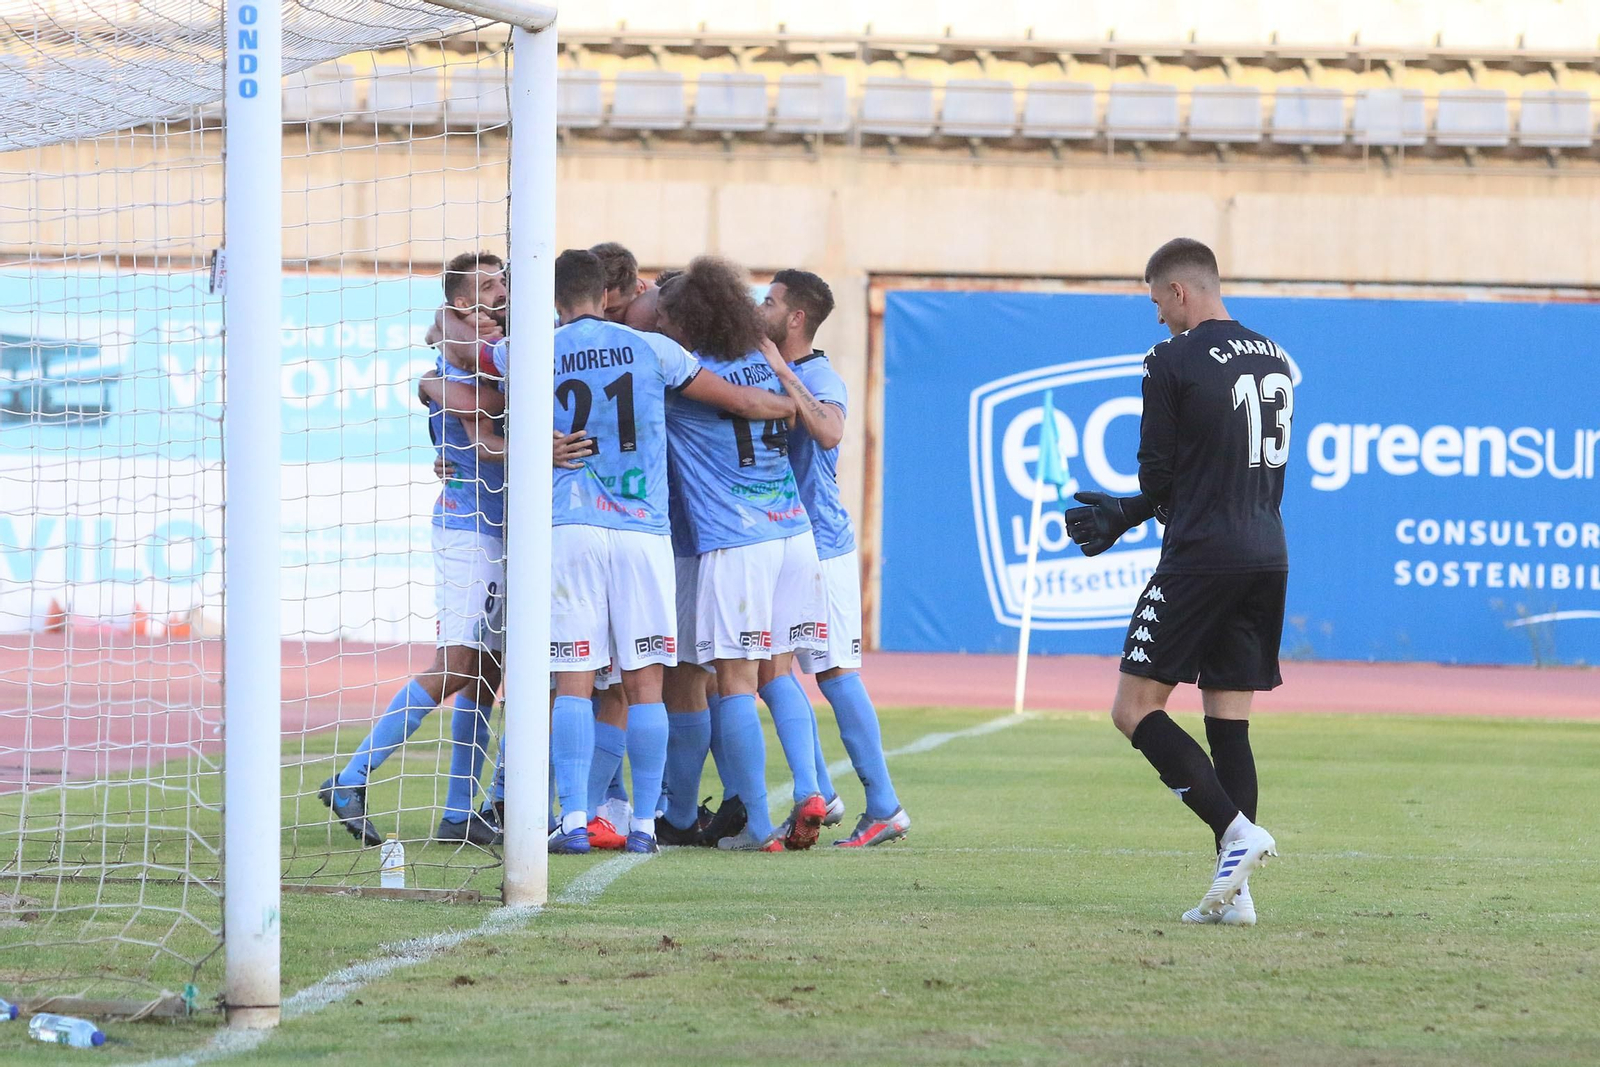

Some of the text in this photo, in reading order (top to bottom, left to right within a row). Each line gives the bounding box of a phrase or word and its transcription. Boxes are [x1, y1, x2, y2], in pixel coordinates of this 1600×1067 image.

[334, 324, 375, 348] DE
[554, 346, 634, 376] .MORENO
[555, 371, 637, 455] 21
[1231, 372, 1294, 469] 13
[1395, 518, 1600, 549] CONSULTOR
[1394, 560, 1600, 590] SOSTENIBIL
